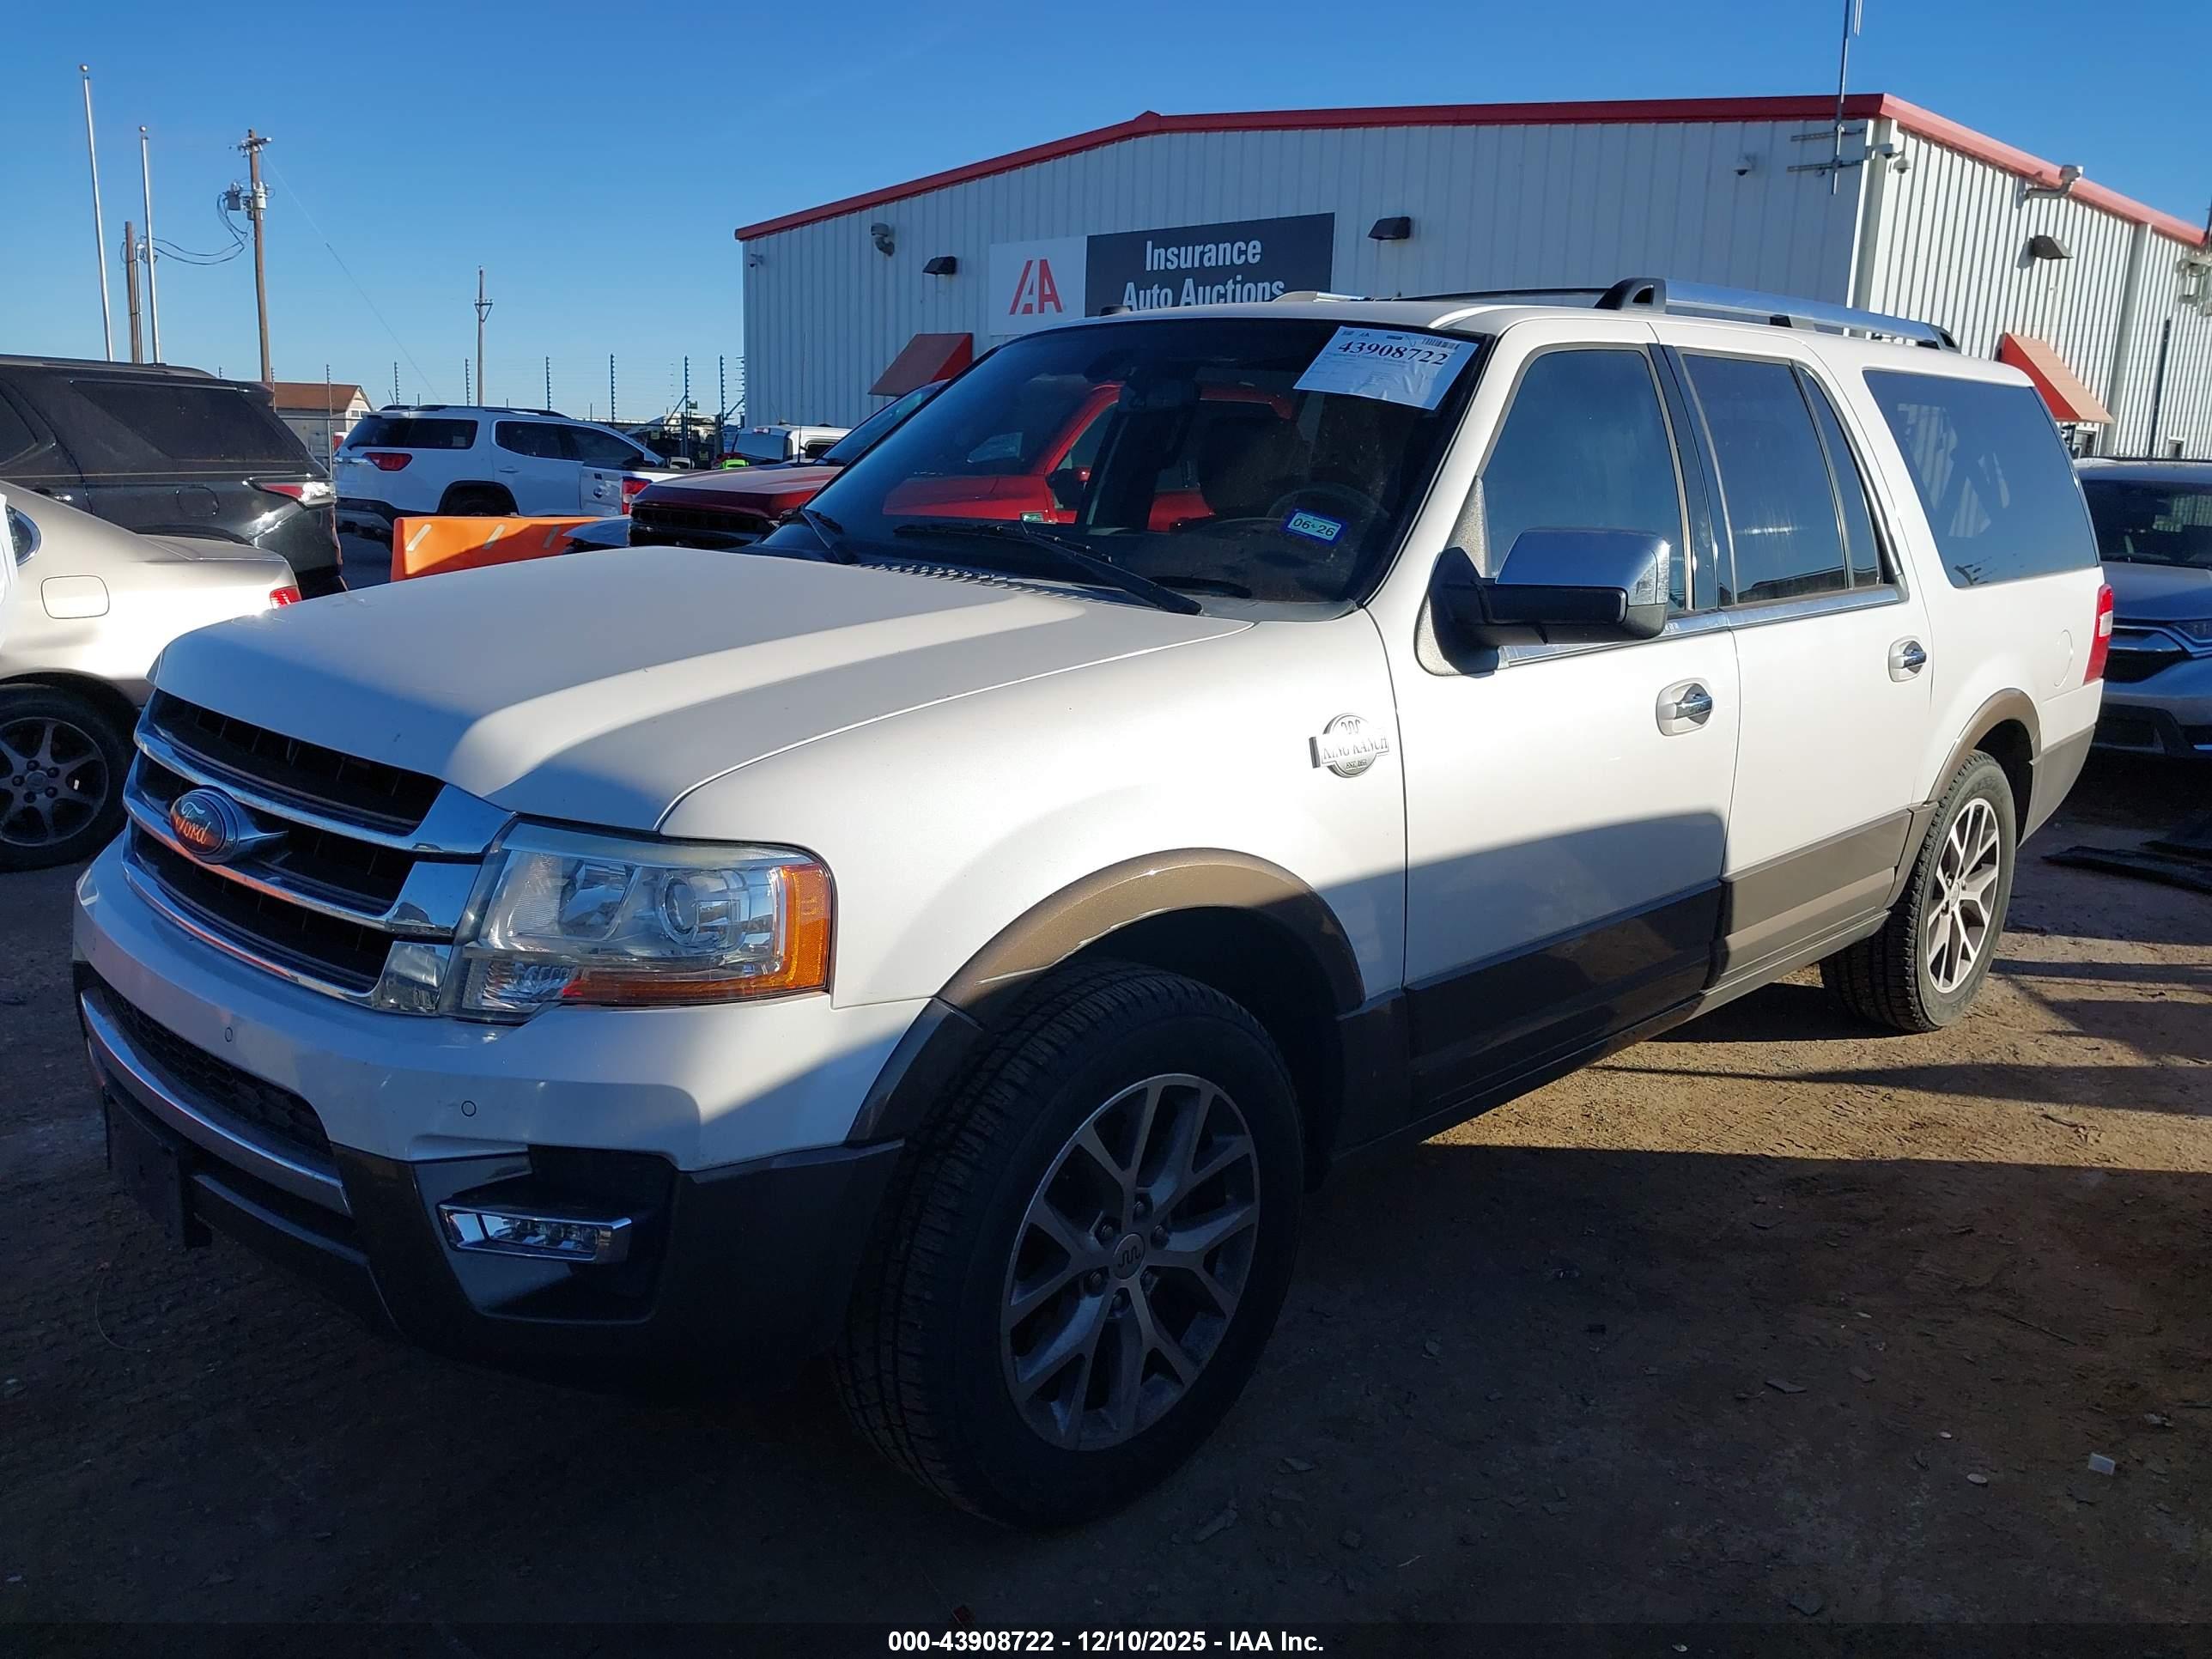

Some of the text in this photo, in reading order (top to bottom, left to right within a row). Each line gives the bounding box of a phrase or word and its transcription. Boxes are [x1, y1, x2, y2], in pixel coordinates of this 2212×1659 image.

[1146, 240, 1261, 271] Insurance
[1122, 274, 1285, 312] Auto Auctions
[1338, 340, 1449, 365] 43908722
[1293, 518, 1335, 537] 06 26
[175, 801, 211, 844] Ford
